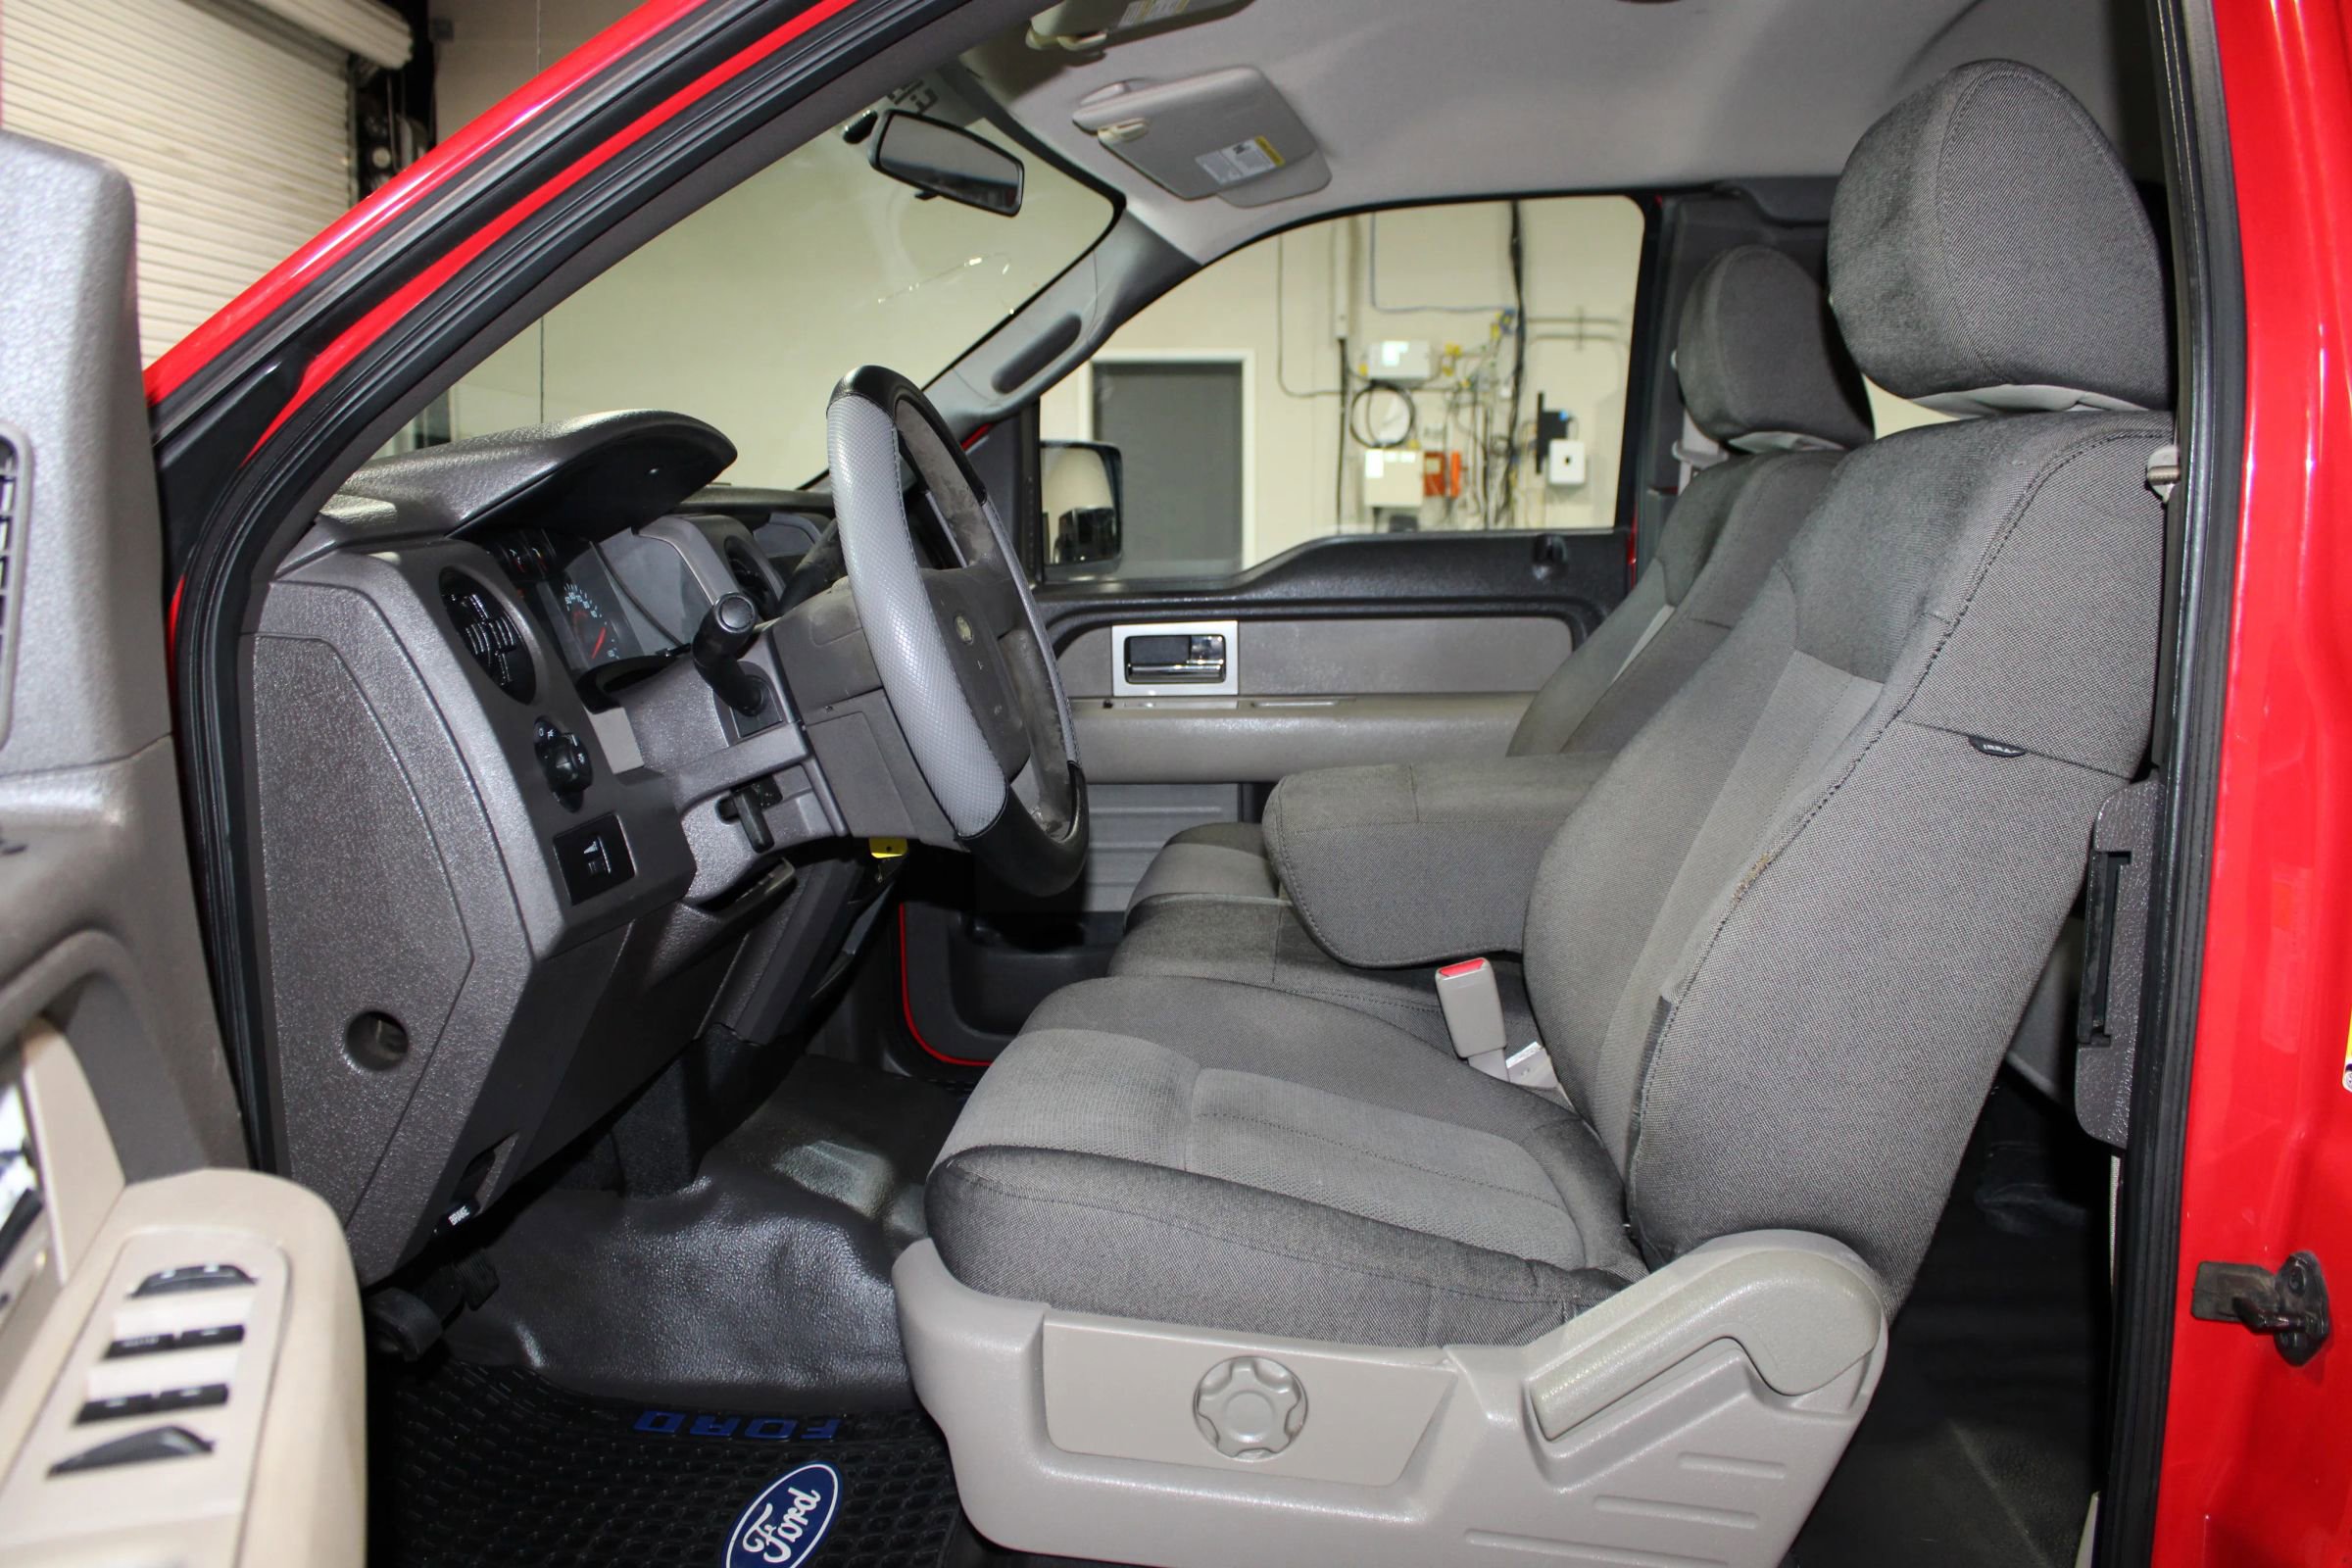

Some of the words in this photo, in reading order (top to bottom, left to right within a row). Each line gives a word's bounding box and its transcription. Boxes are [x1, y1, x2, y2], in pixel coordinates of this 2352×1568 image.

[449, 1204, 470, 1226] BRAKE
[631, 1409, 843, 1440] FORD
[742, 1486, 821, 1564] Ford
